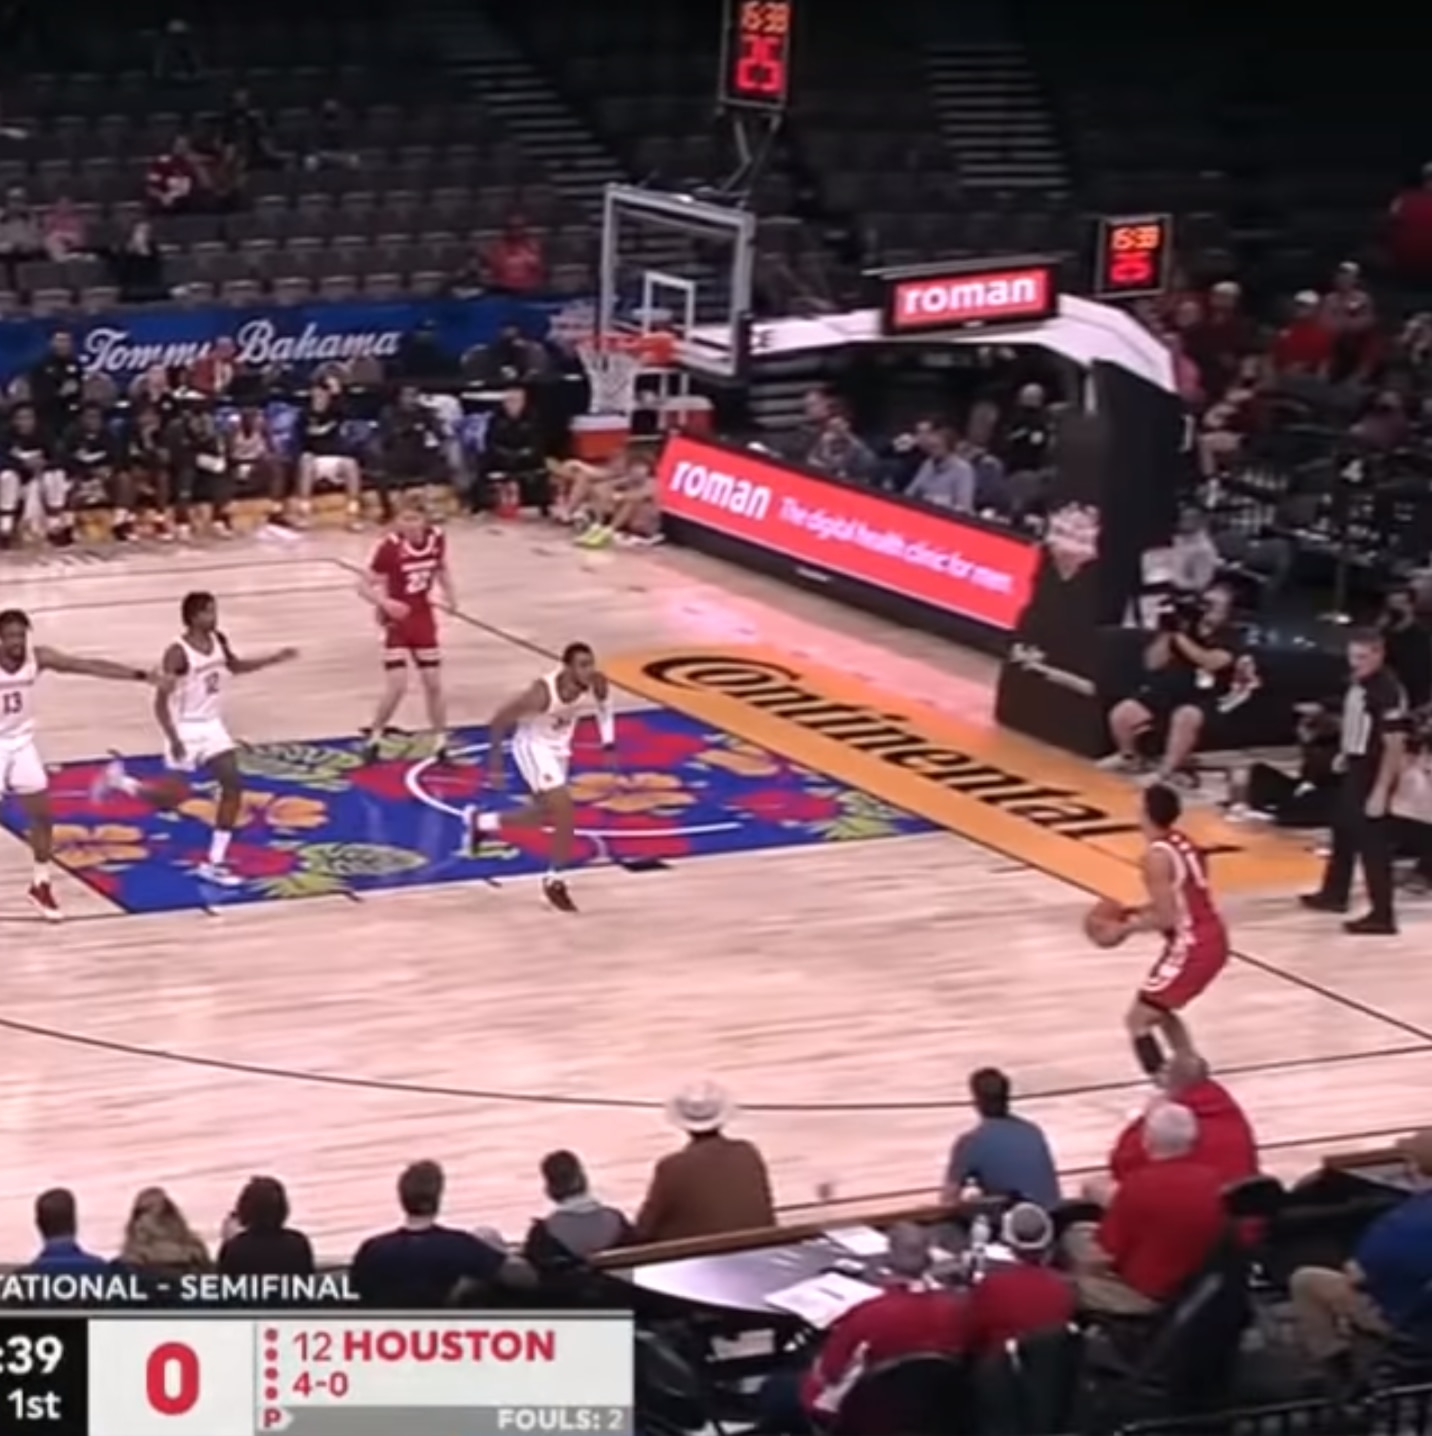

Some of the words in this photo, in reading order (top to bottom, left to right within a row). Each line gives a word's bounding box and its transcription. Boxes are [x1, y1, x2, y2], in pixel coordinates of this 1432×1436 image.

[905, 278, 1035, 313] roman
[236, 319, 402, 363] Bahama
[670, 461, 771, 521] roman
[3, 691, 23, 715] 13
[641, 656, 1144, 841] Continental
